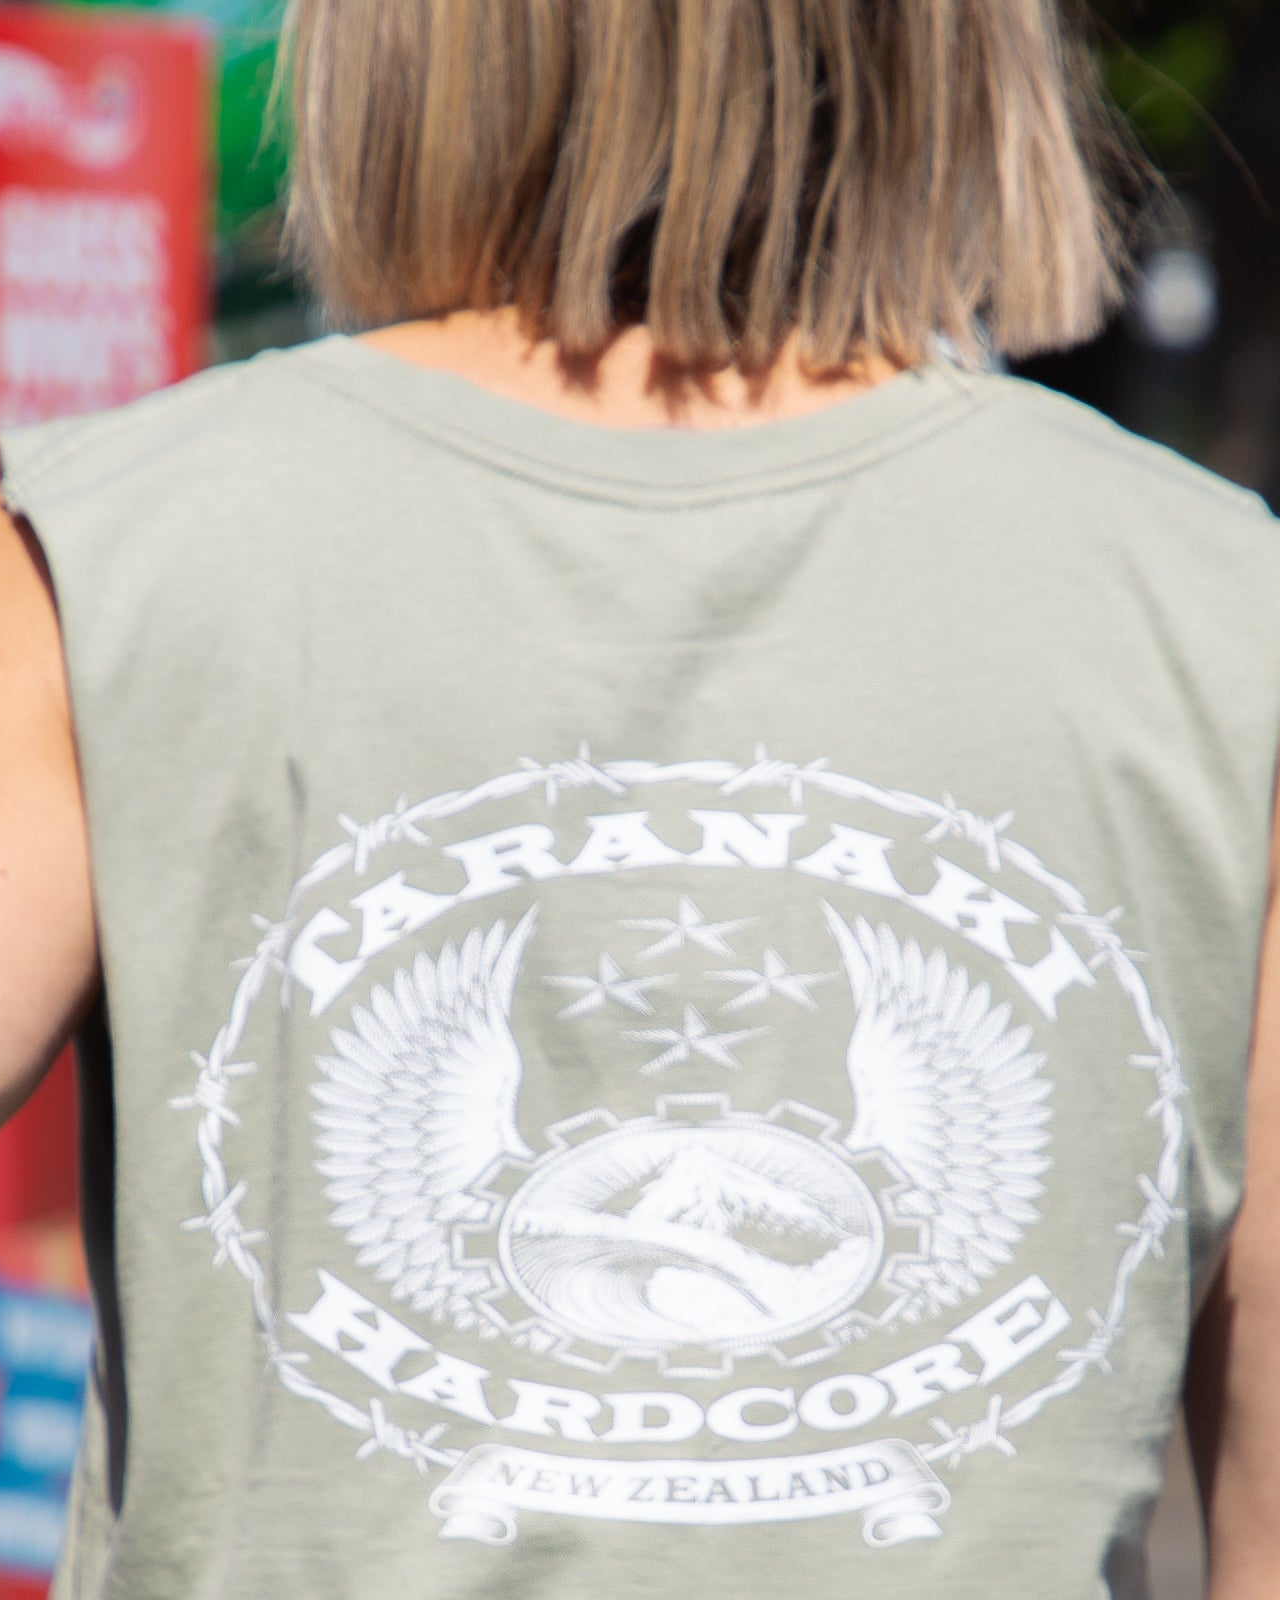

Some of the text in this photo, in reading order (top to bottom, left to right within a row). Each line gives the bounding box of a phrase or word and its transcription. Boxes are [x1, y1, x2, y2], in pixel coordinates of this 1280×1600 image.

[288, 809, 1096, 1020] TARANAKI
[288, 1269, 1072, 1444] HARDCORE
[488, 1458, 894, 1505] NEW ZEALAND
